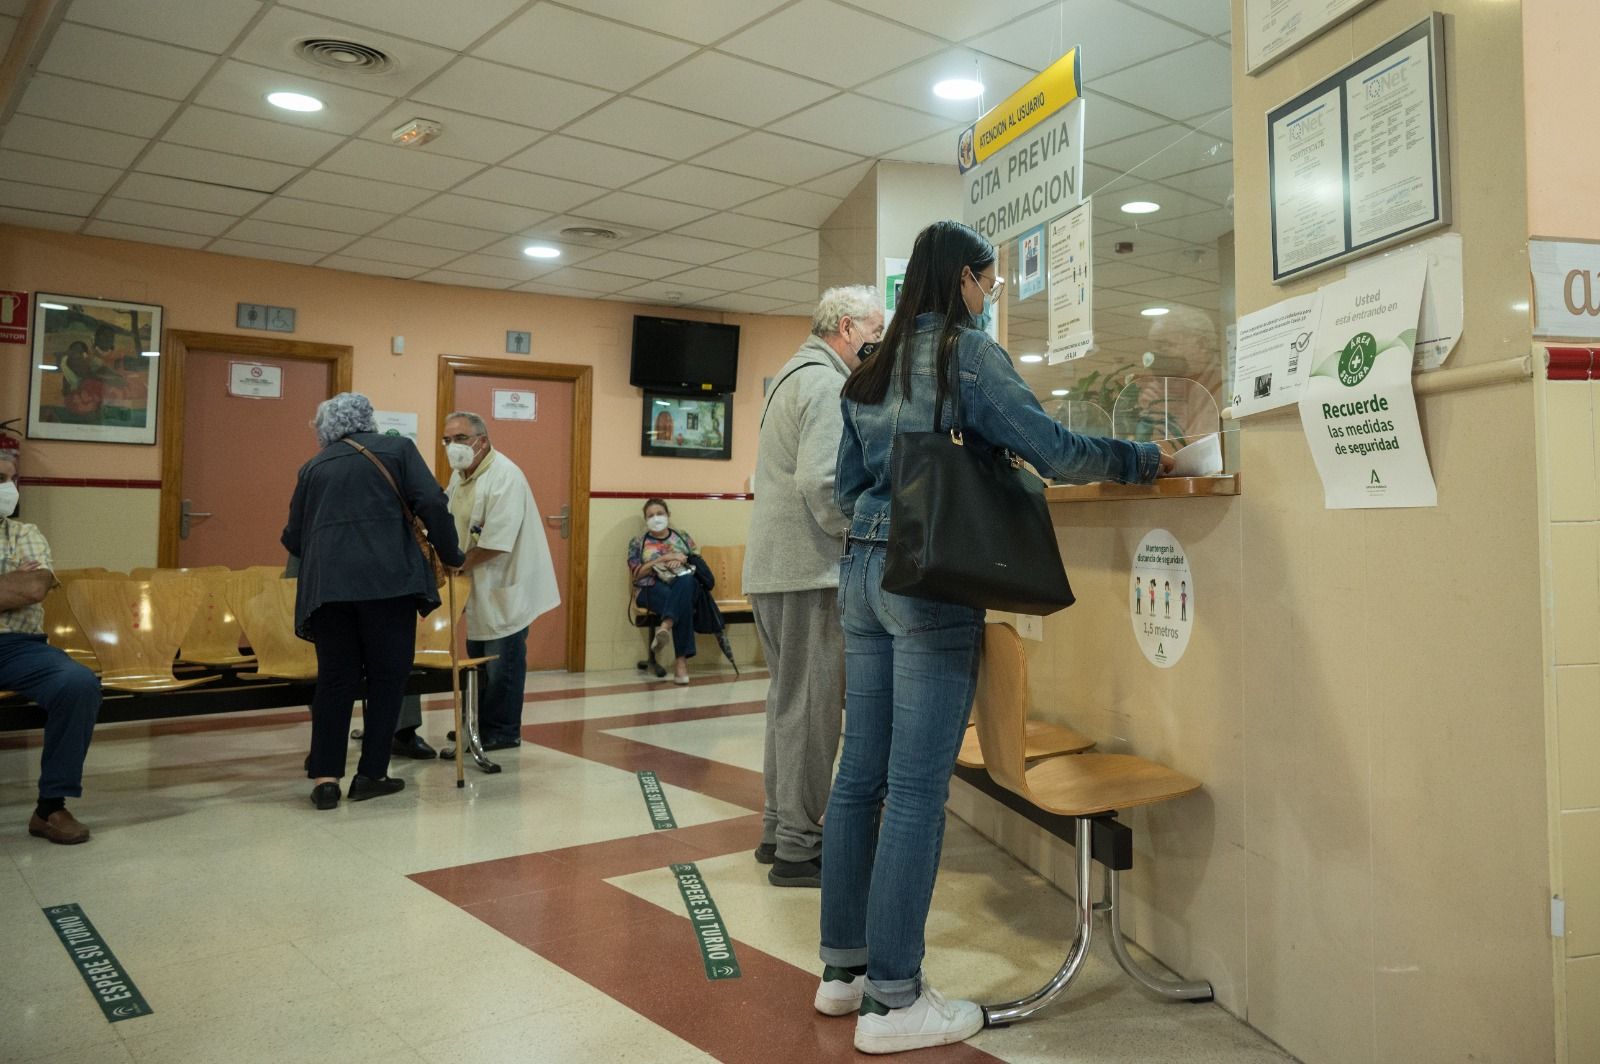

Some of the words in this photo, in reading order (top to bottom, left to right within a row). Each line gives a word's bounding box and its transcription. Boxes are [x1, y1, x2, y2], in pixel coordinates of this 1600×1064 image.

[979, 119, 1007, 148] ATENCION
[1008, 112, 1017, 128] AL
[1016, 91, 1045, 122] USUARIO
[970, 167, 1001, 205] CITA
[1007, 121, 1070, 184] PREVIA
[1355, 288, 1381, 307] Usted
[1563, 268, 1600, 317] a
[1335, 312, 1350, 326] está
[1351, 304, 1387, 322] entrando
[1388, 302, 1398, 312] en
[1340, 366, 1369, 385] SEGURA
[1322, 393, 1389, 420] Recuerde
[1327, 424, 1344, 438] las
[1345, 418, 1394, 437] medidas
[1334, 442, 1347, 455] de
[1348, 435, 1400, 456] seguridad
[1137, 553, 1156, 562] distancia
[1162, 555, 1184, 565] seguridad
[1145, 544, 1169, 554] Mantengan
[1169, 544, 1175, 552] la
[1143, 622, 1154, 637] 1,5
[1154, 625, 1179, 640] metros
[641, 776, 660, 793] ESPERE
[647, 793, 663, 801] SU
[649, 801, 670, 821] TURNO
[679, 874, 709, 906] ESPERE
[693, 907, 716, 921] SU
[56, 915, 94, 946] TURNO
[699, 922, 730, 960] TURNO
[74, 944, 104, 959] SU
[83, 959, 132, 1002] ESPERE
